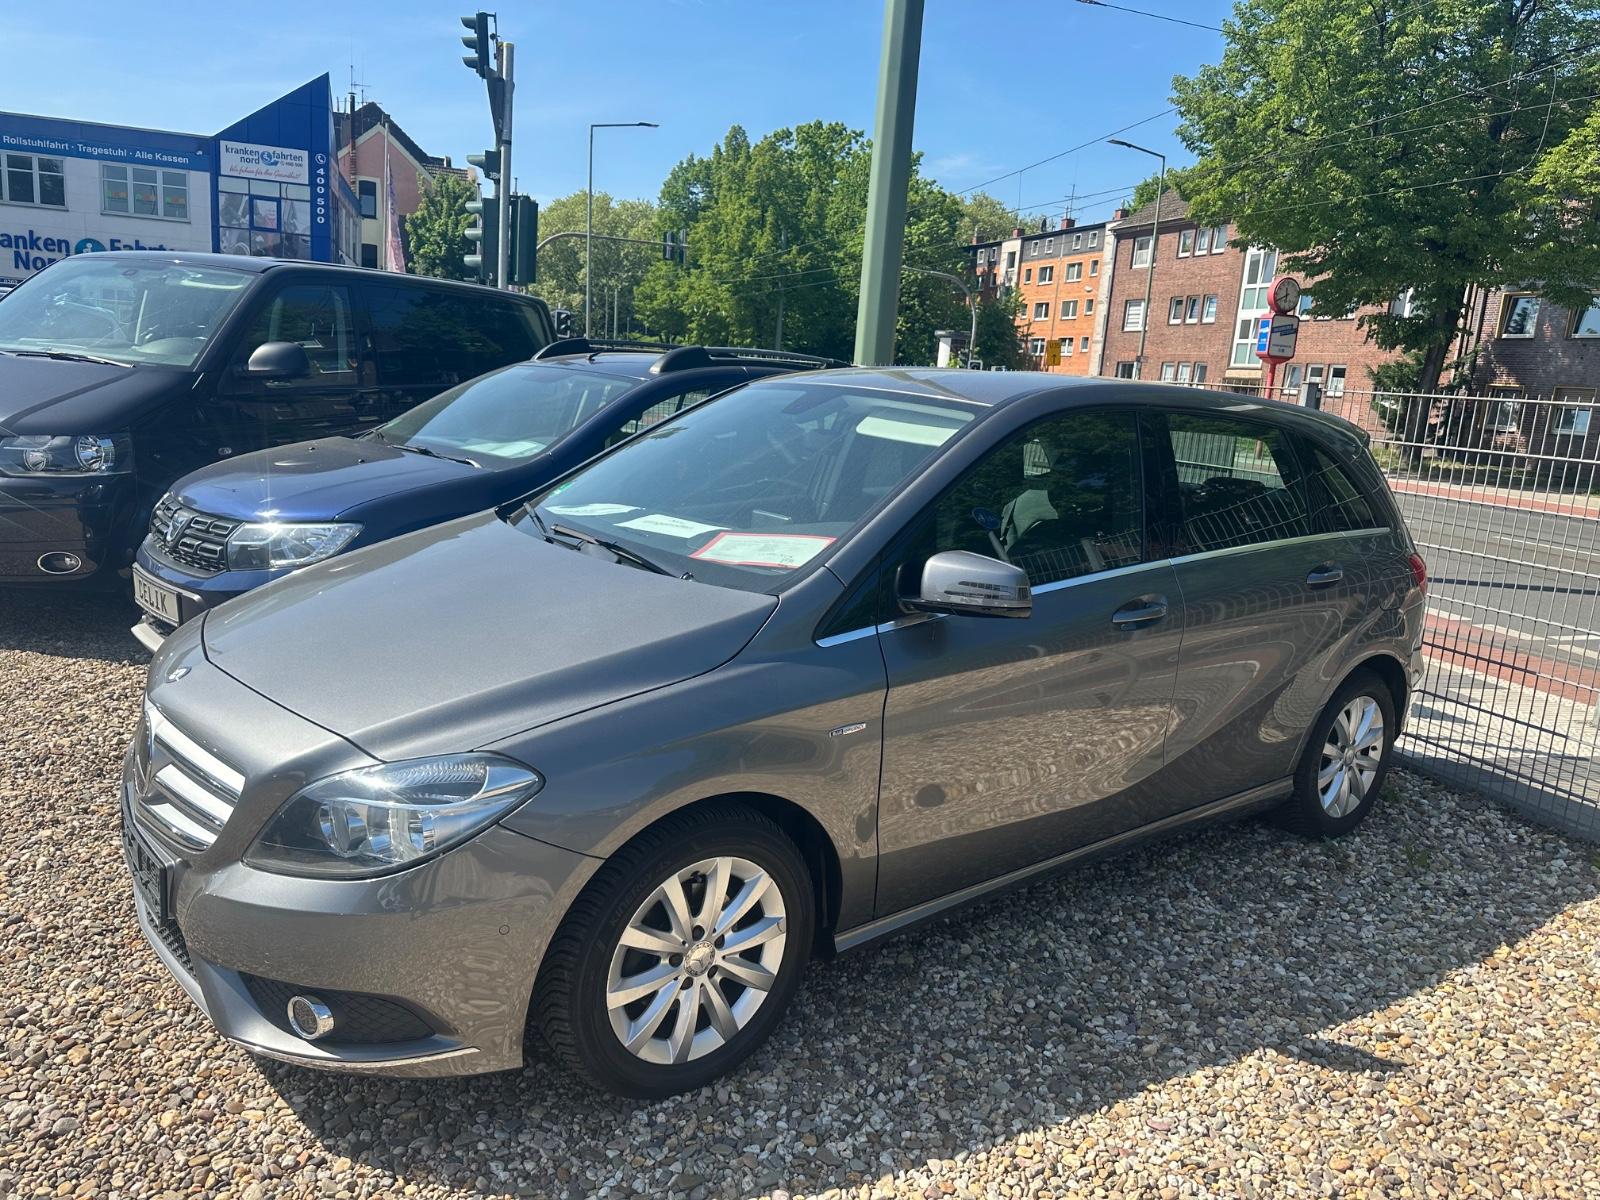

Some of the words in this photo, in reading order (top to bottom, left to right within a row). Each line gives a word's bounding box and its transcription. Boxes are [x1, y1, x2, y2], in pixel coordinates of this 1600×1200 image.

[3, 135, 69, 150] Rollstuhlfahrt
[77, 143, 127, 157] Tragestuhl
[135, 150, 153, 160] Alle
[155, 152, 189, 164] Kassen
[225, 145, 260, 157] kranken
[272, 150, 303, 162] fahrten
[239, 155, 260, 165] nord
[316, 168, 325, 194] 400
[316, 197, 325, 224] 500
